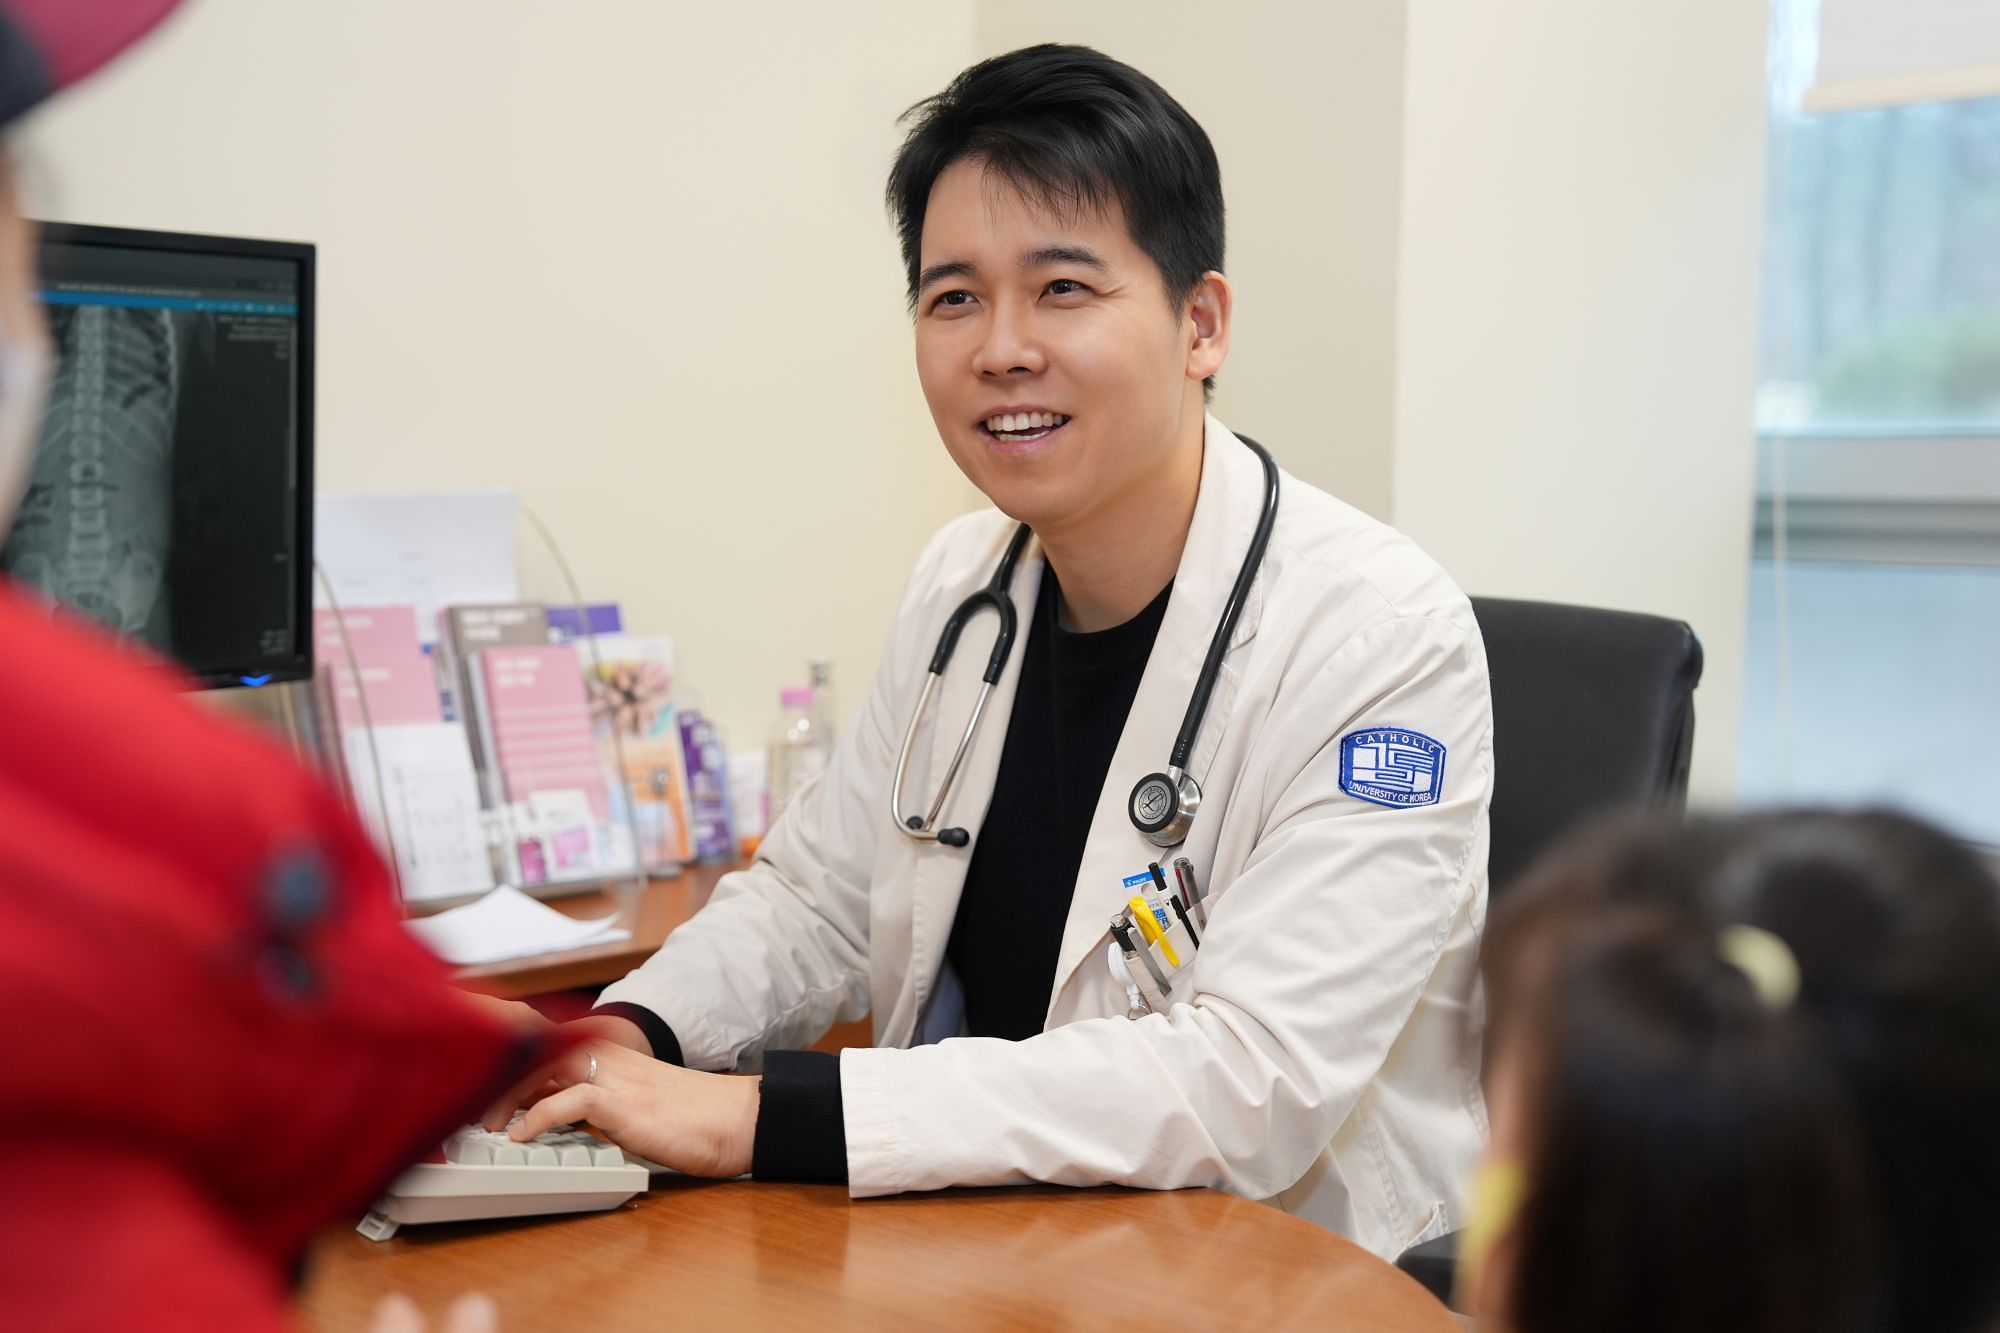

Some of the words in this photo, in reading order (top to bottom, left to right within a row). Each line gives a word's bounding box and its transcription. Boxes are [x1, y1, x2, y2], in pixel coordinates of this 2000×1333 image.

[1355, 734, 1435, 753] CATHOLIC
[1348, 780, 1398, 801] UNIVERSITY
[1398, 793, 1409, 803] OF
[1409, 792, 1432, 803] KOREA
[1132, 877, 1146, 885] PILOT
